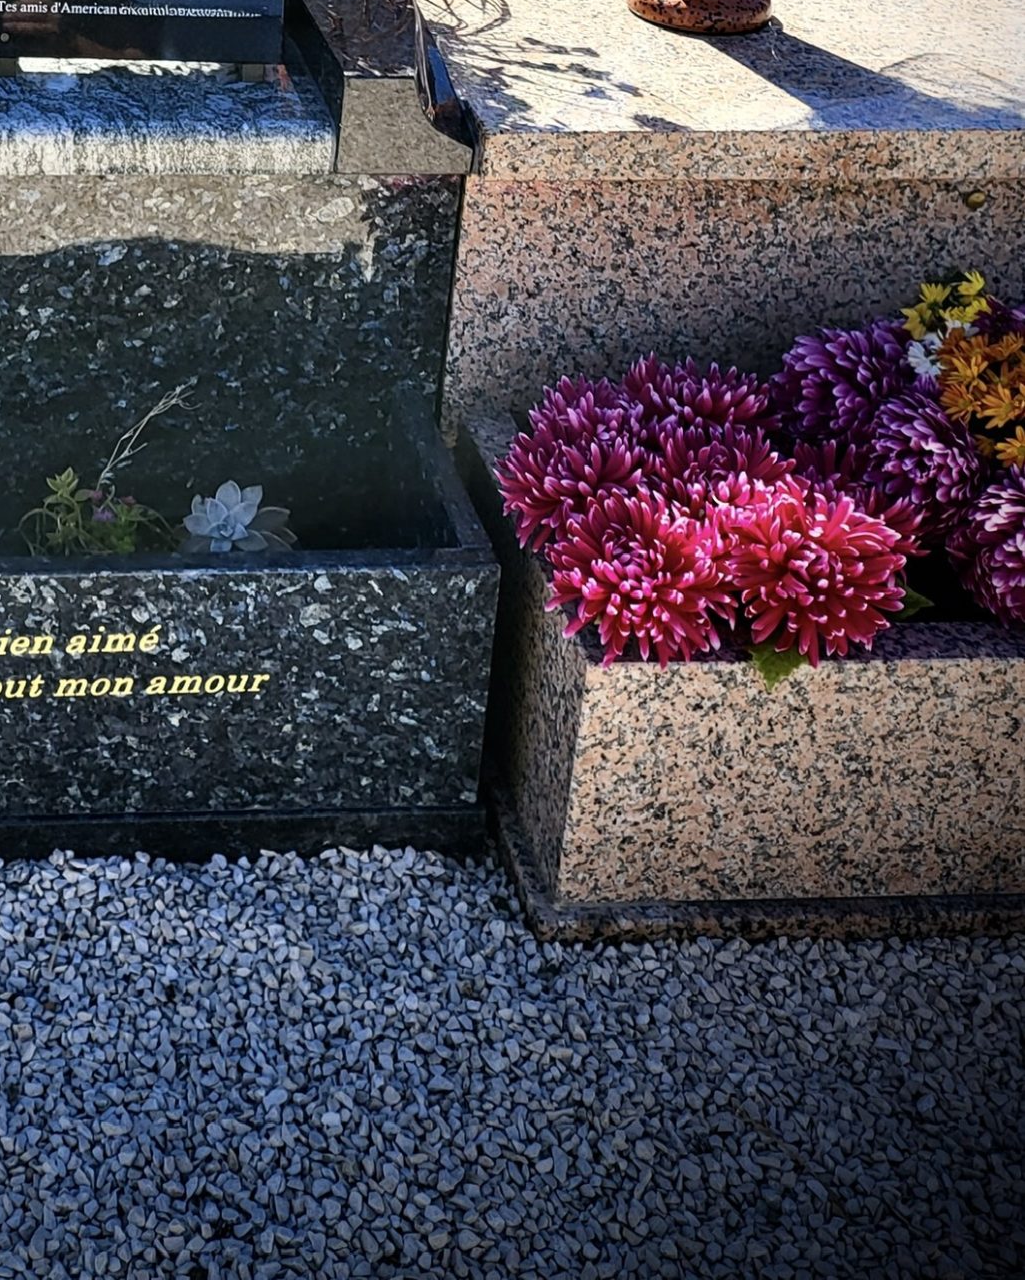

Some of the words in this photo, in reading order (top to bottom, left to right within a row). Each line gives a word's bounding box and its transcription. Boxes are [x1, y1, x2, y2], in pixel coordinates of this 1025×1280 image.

[20, 4, 48, 13] amis
[50, 2, 118, 15] d'American
[65, 624, 162, 654] aimé
[52, 675, 136, 698] mon
[144, 672, 270, 696] amour
